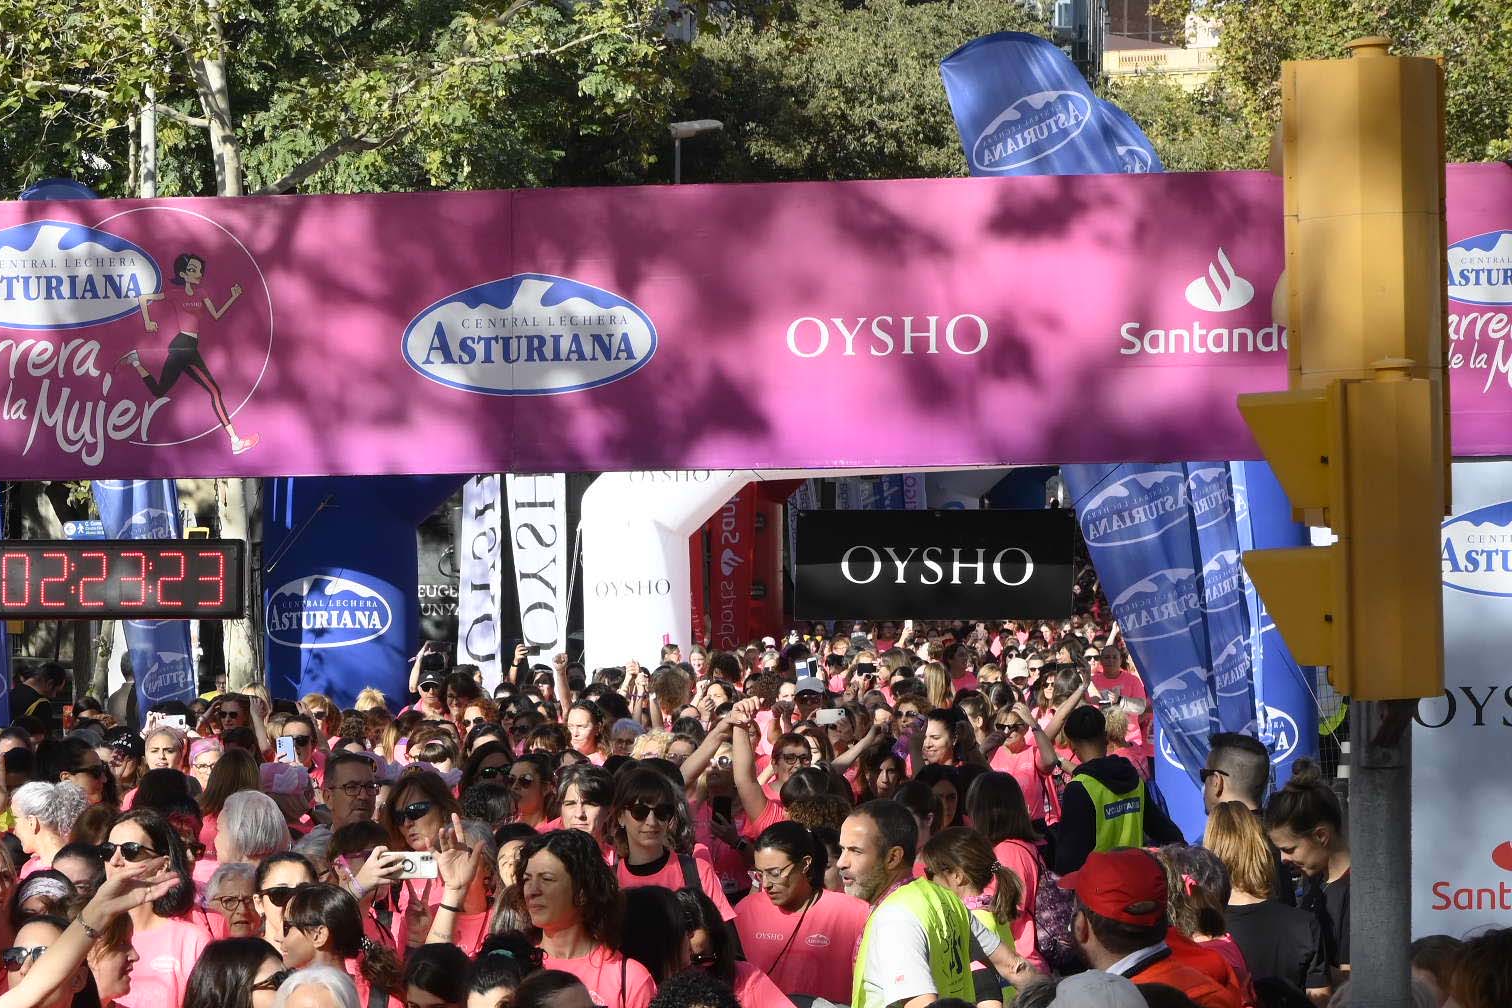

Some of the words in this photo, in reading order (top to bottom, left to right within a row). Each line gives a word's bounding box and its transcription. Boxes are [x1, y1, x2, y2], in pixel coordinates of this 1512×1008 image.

[64, 257, 137, 268] LECHERA
[461, 315, 540, 330] CENTRAL
[548, 314, 629, 326] LECHERA
[786, 313, 990, 359] OYSHO
[422, 320, 638, 365] ASTURIANA
[1120, 321, 1288, 356] Santand
[1470, 341, 1489, 369] la
[3, 380, 28, 421] la
[22, 371, 172, 467] Mujer
[1, 552, 224, 607] 02:23:23
[841, 545, 1035, 586] OYSHO
[418, 585, 457, 598] EUGE
[595, 578, 671, 598] OYSHO
[328, 599, 378, 608] LECHERA
[270, 604, 383, 632] ASTURIANA
[1432, 882, 1512, 911] Sant
